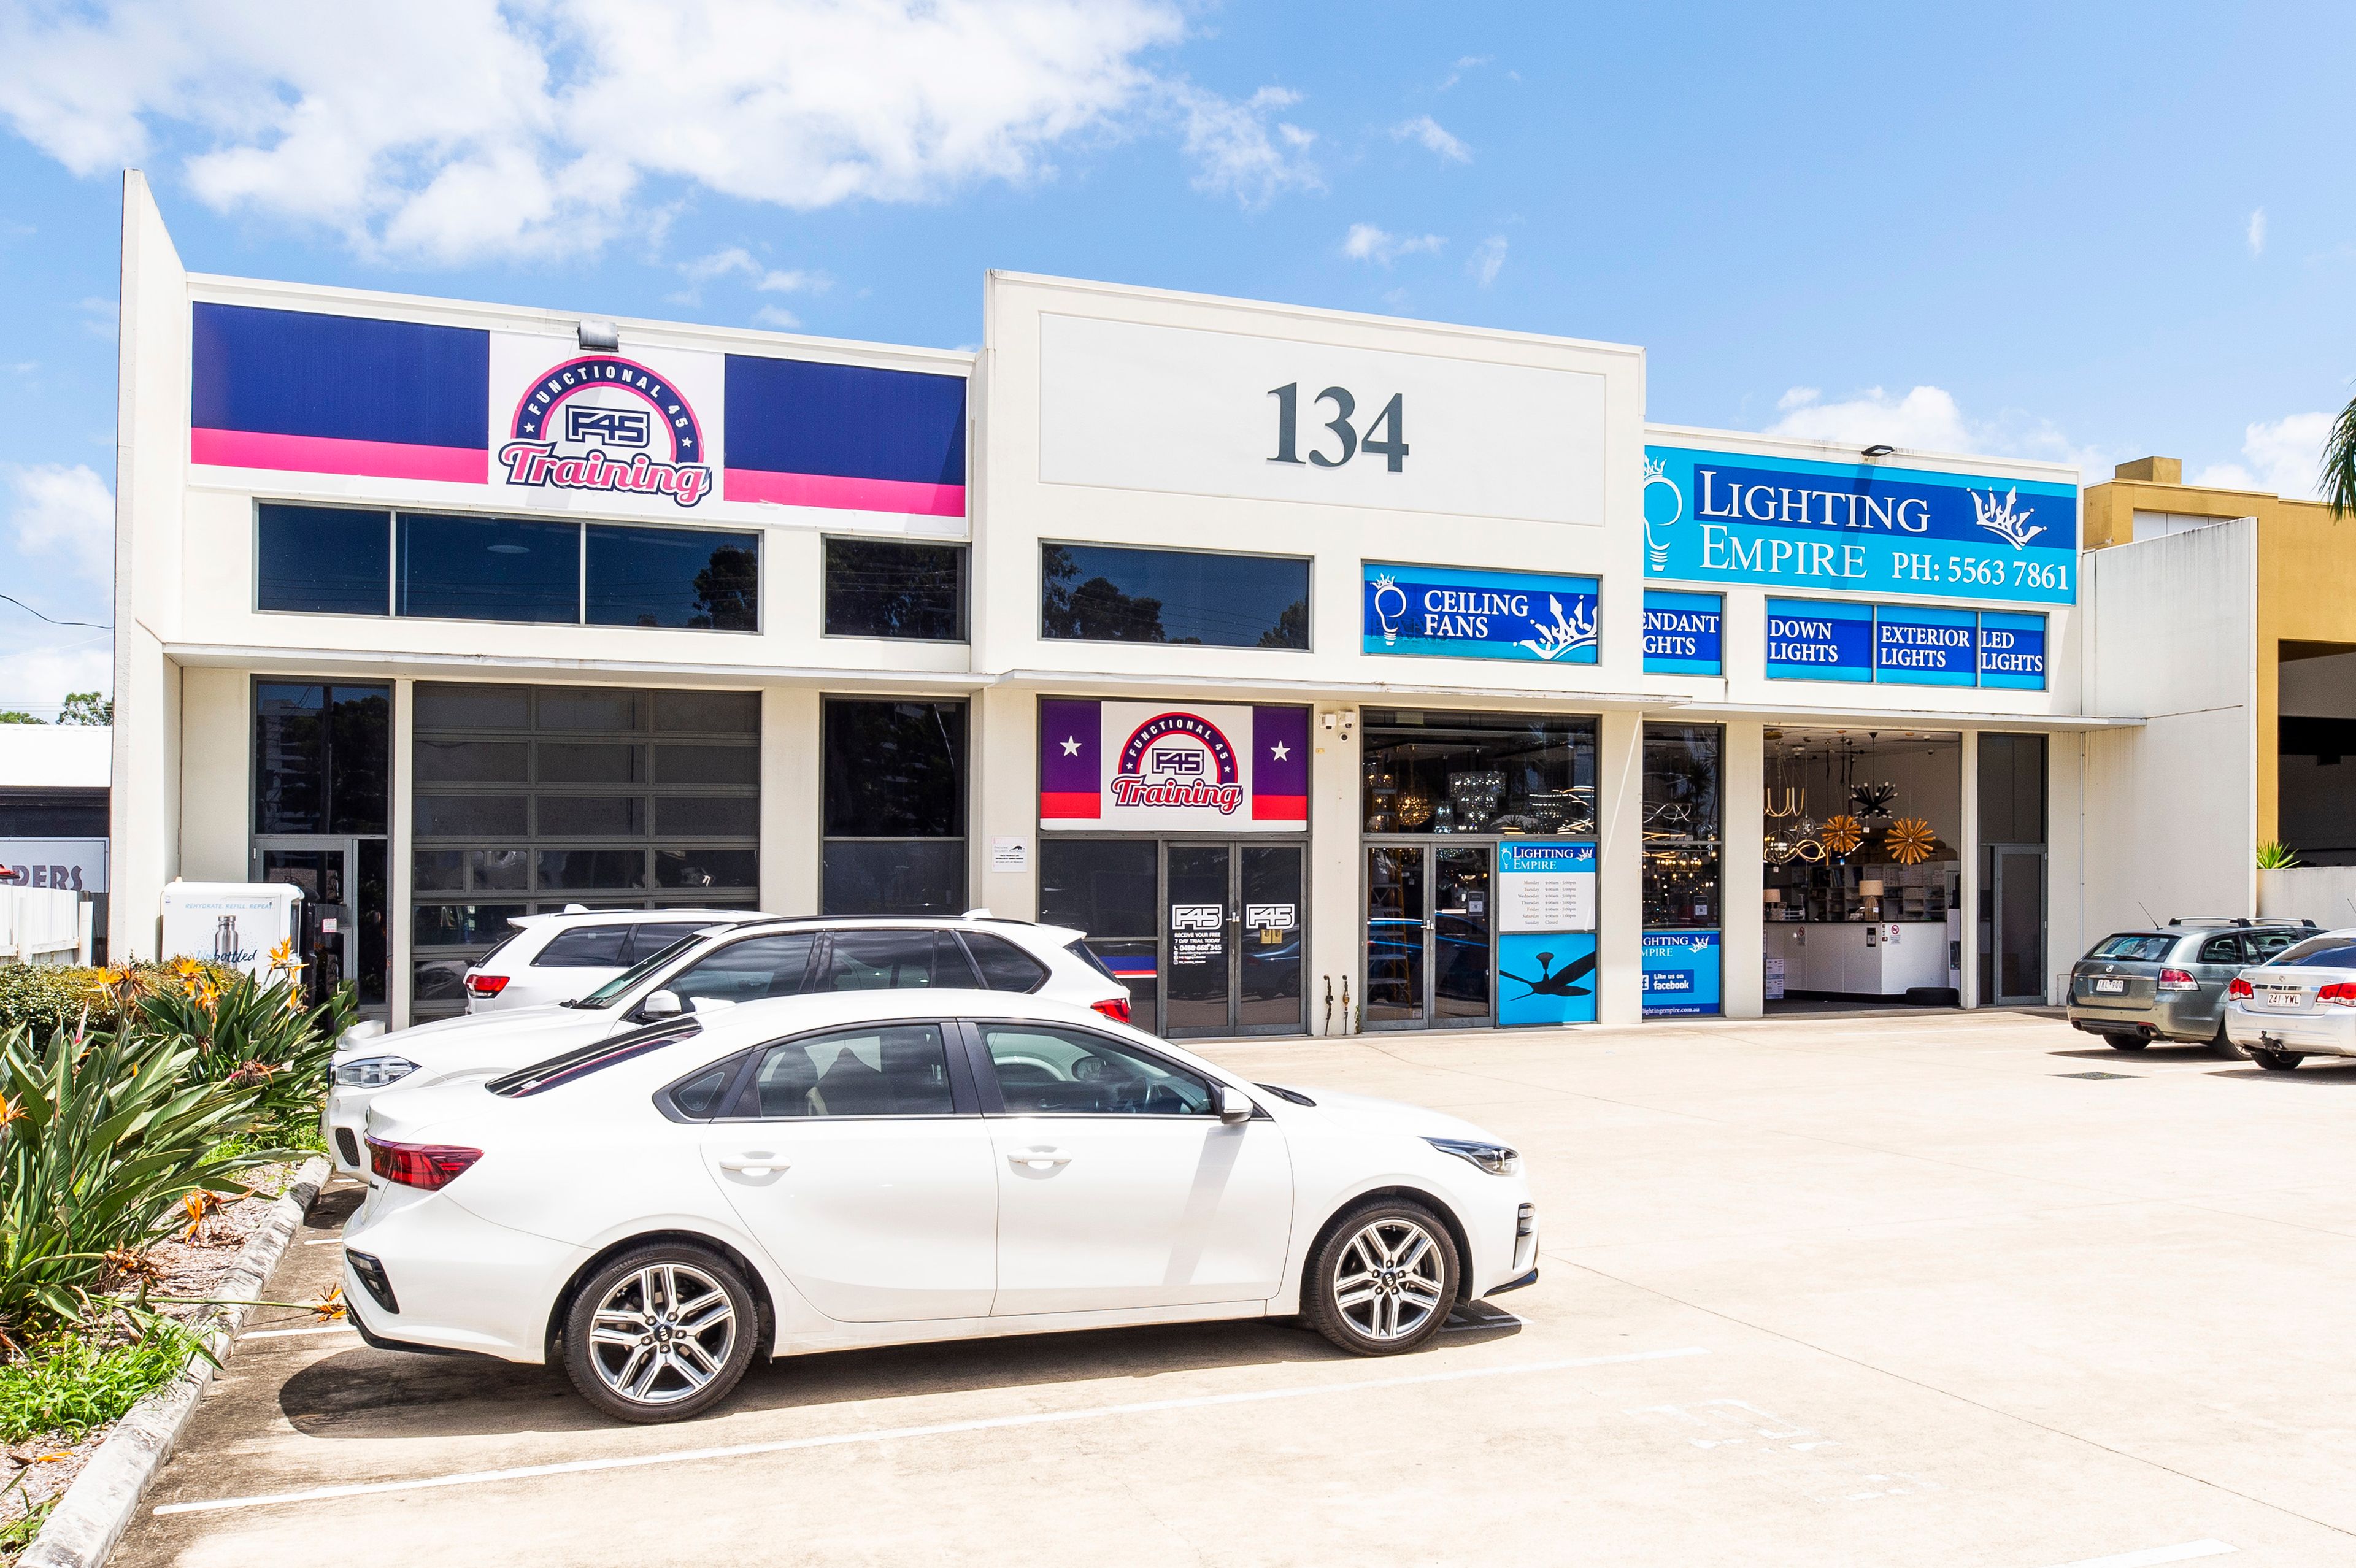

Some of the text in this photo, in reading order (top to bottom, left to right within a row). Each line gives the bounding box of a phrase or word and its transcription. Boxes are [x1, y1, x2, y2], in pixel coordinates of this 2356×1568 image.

[528, 366, 688, 428] FUNCTIONAL 45
[568, 407, 648, 445] F45
[1266, 382, 1409, 472] 134
[501, 443, 707, 505] Training
[1698, 470, 1931, 533] LIGHTING
[1698, 523, 1868, 580] EMPIRE
[1892, 551, 2069, 591] PH: 5563 7861
[1424, 590, 1529, 617] CEILING
[1423, 613, 1488, 639] FANS
[1769, 619, 1833, 641] DOWN
[1881, 626, 1971, 648] EXTERIOR
[1769, 642, 1838, 663] LIGHTS
[1981, 631, 2015, 650] LED
[1881, 648, 1946, 669] LIGHTS
[1981, 652, 2043, 672] LIGHTS
[1129, 718, 1229, 760] FUNCTIONAL 45
[1153, 750, 1203, 774] F45
[1112, 777, 1241, 813] Training
[1514, 846, 1574, 859] LIGHTING
[1514, 858, 1557, 870] EMPIRE
[9, 865, 83, 891] DERS
[1173, 905, 1222, 929] F45
[1247, 904, 1294, 928] F45
[1642, 936, 1688, 946] GHTING
[1653, 980, 1689, 990] facebook
[2268, 994, 2299, 1004] 241 YWL
